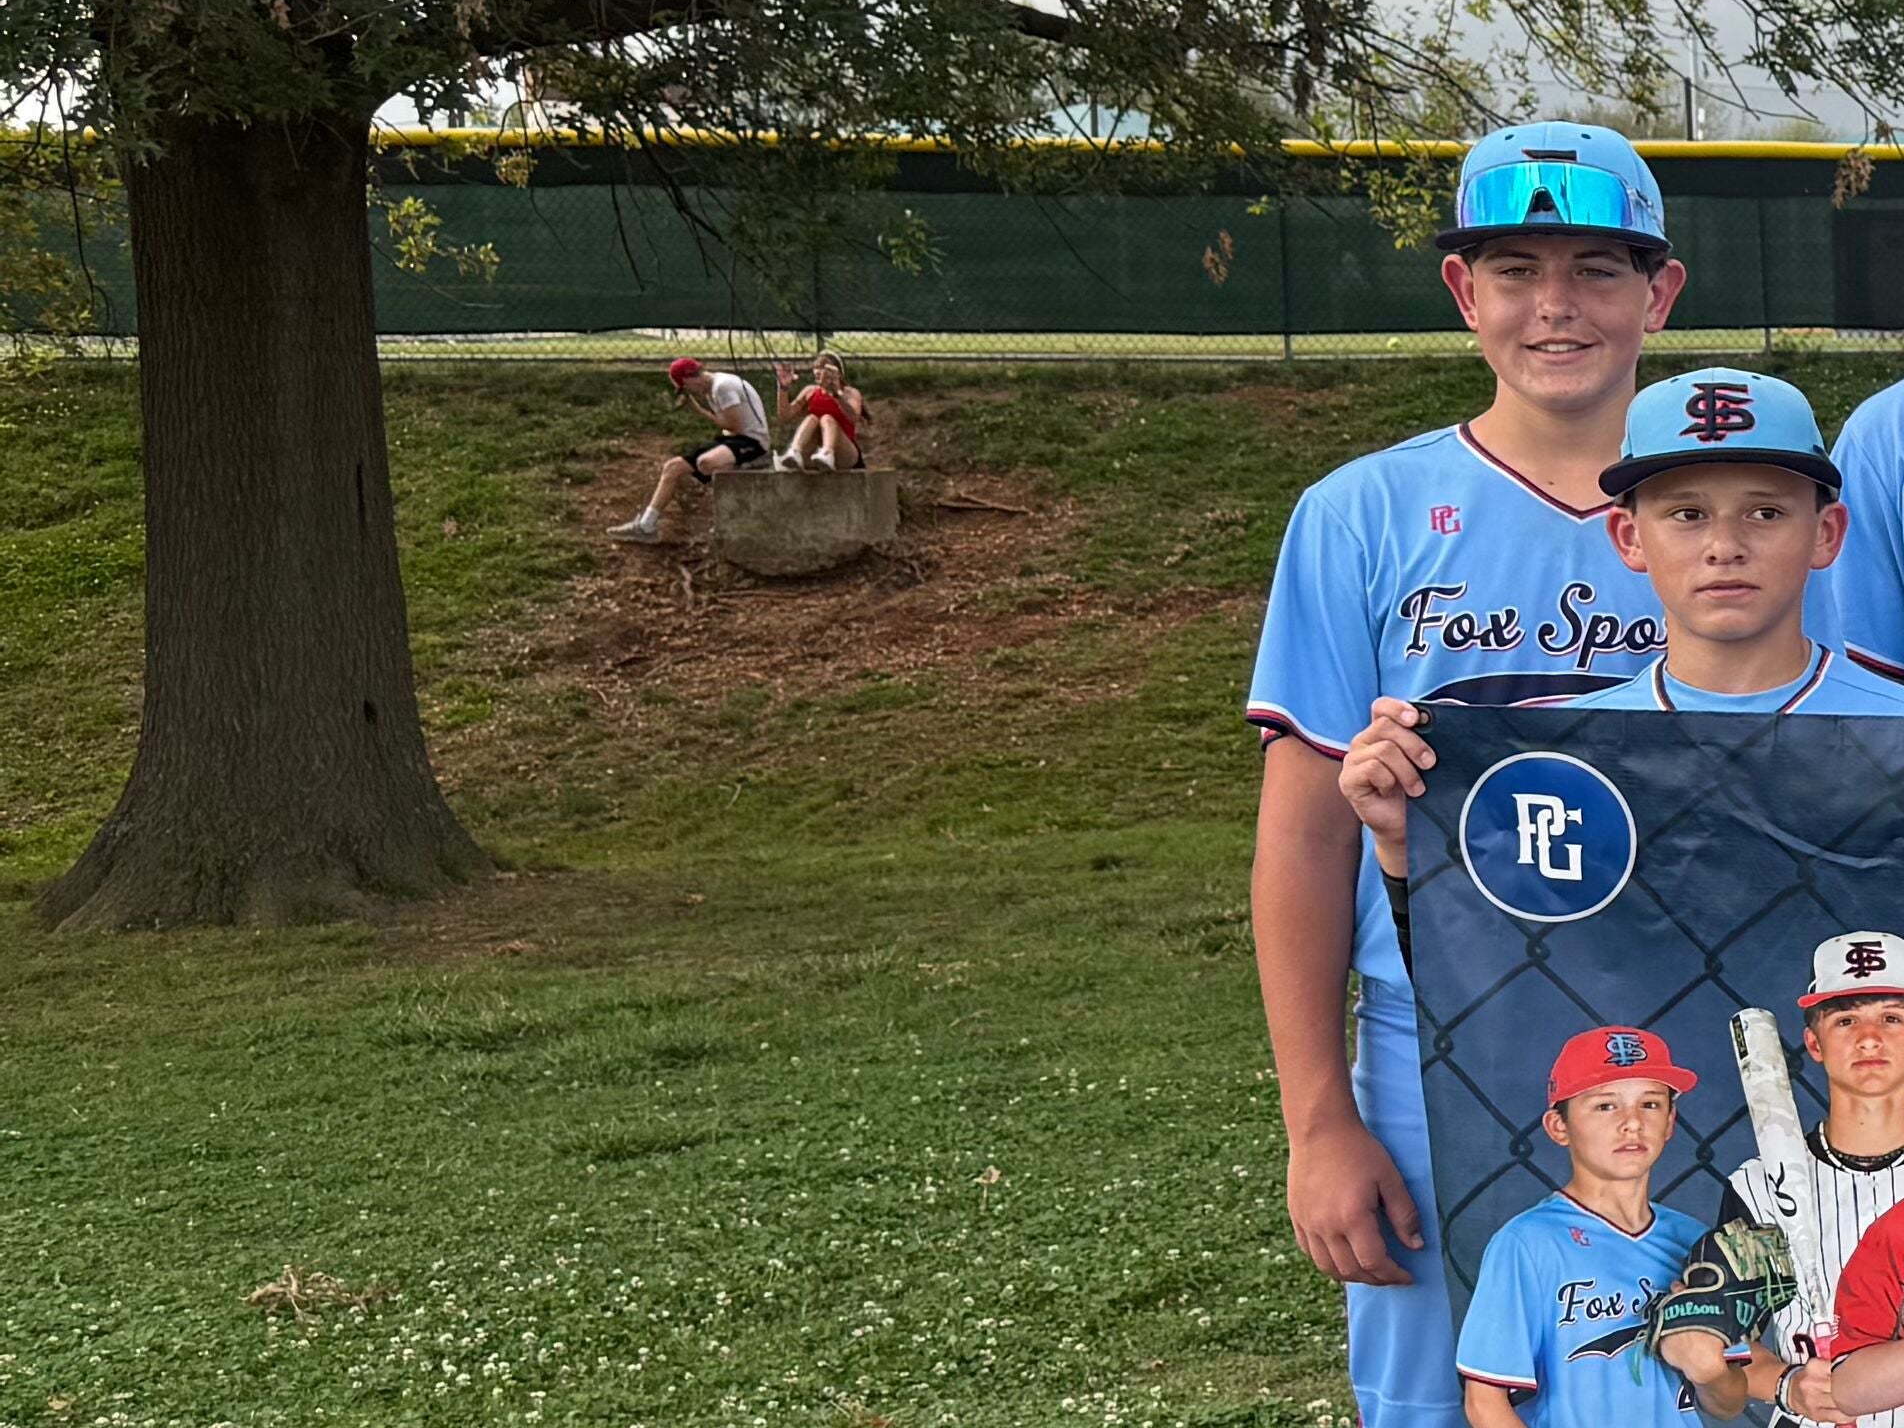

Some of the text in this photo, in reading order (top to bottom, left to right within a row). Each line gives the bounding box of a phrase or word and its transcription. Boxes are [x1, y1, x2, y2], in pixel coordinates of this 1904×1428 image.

[1400, 580, 1668, 670] Fox Spo
[1512, 793, 1583, 881] PG
[1556, 1277, 1626, 1329] Fox
[1664, 1301, 1722, 1322] Wilson
